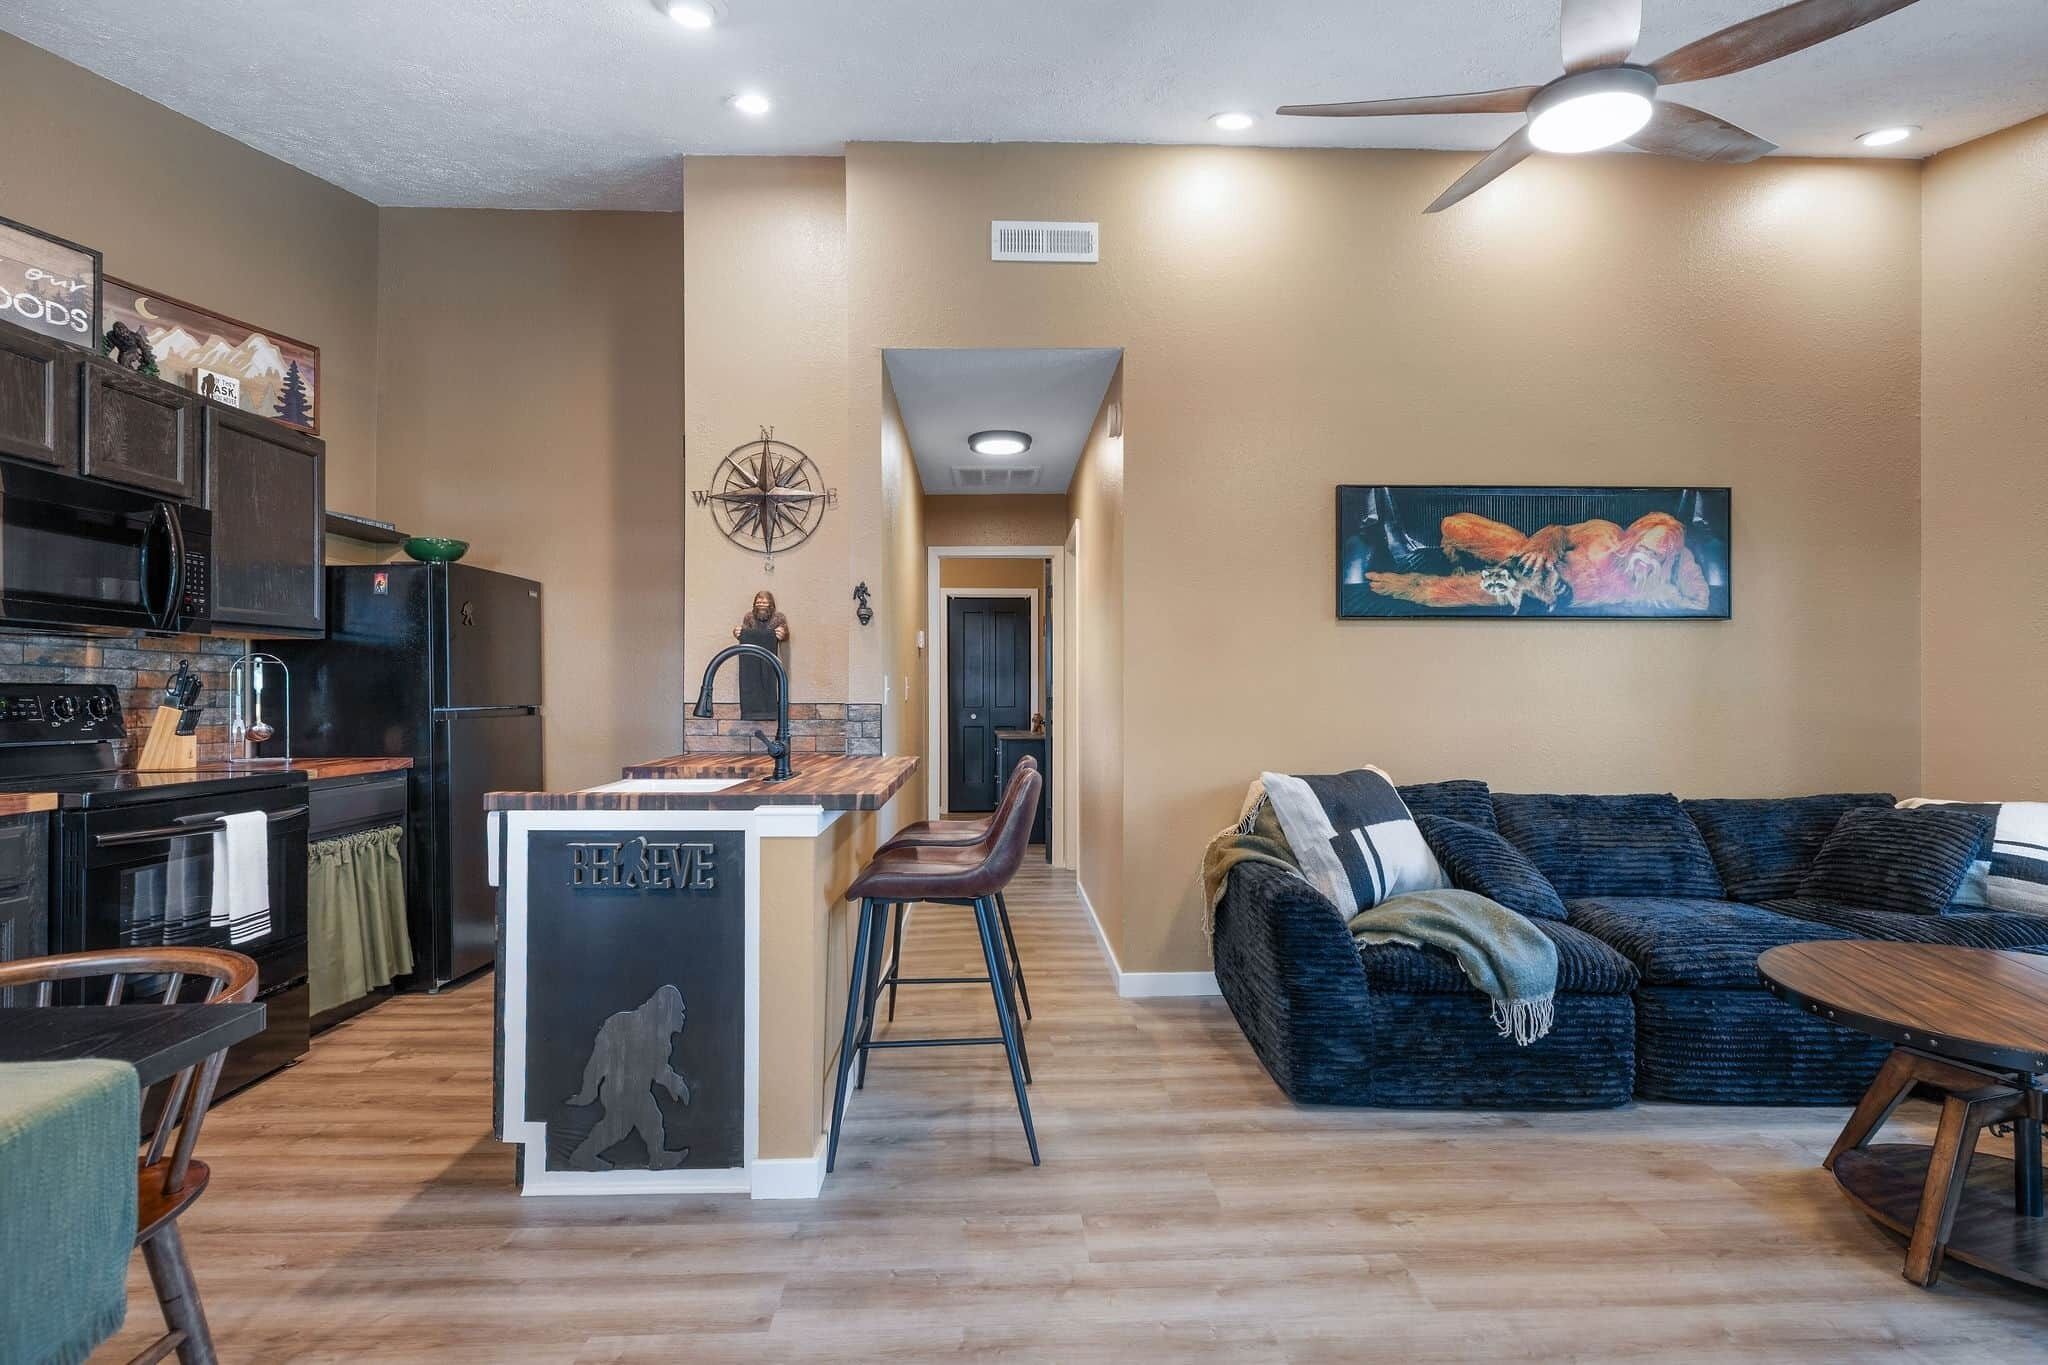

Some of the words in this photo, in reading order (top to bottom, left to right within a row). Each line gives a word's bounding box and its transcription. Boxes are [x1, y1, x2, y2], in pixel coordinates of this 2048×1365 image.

[25, 268, 87, 292] our
[760, 424, 775, 441] N
[691, 490, 710, 506] W
